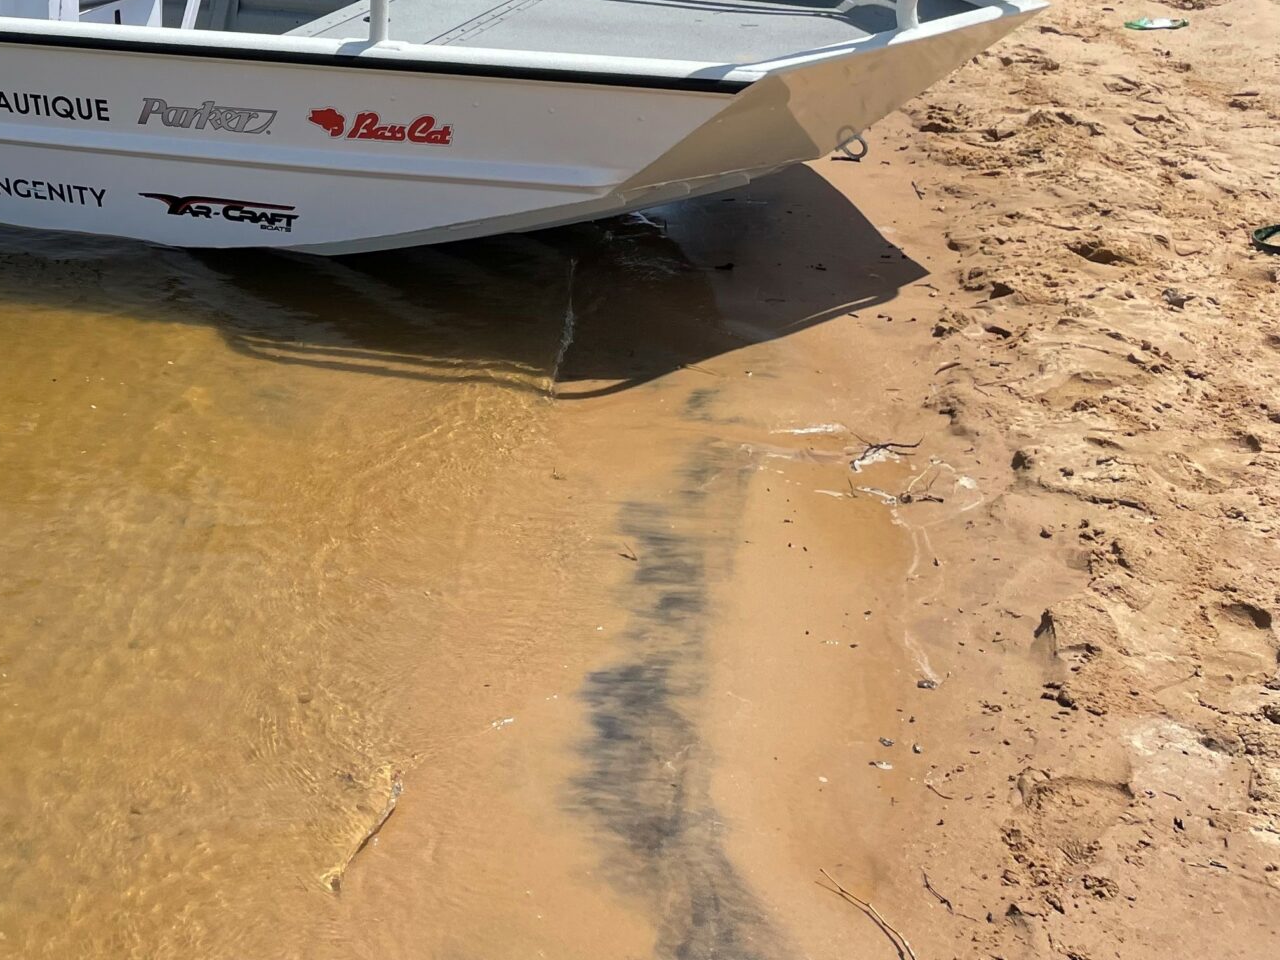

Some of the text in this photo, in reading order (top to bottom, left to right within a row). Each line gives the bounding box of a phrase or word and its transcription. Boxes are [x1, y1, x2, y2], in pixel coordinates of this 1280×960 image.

[137, 97, 277, 134] Parker
[346, 111, 451, 144] Bass Cat
[260, 224, 291, 232] BOATS
